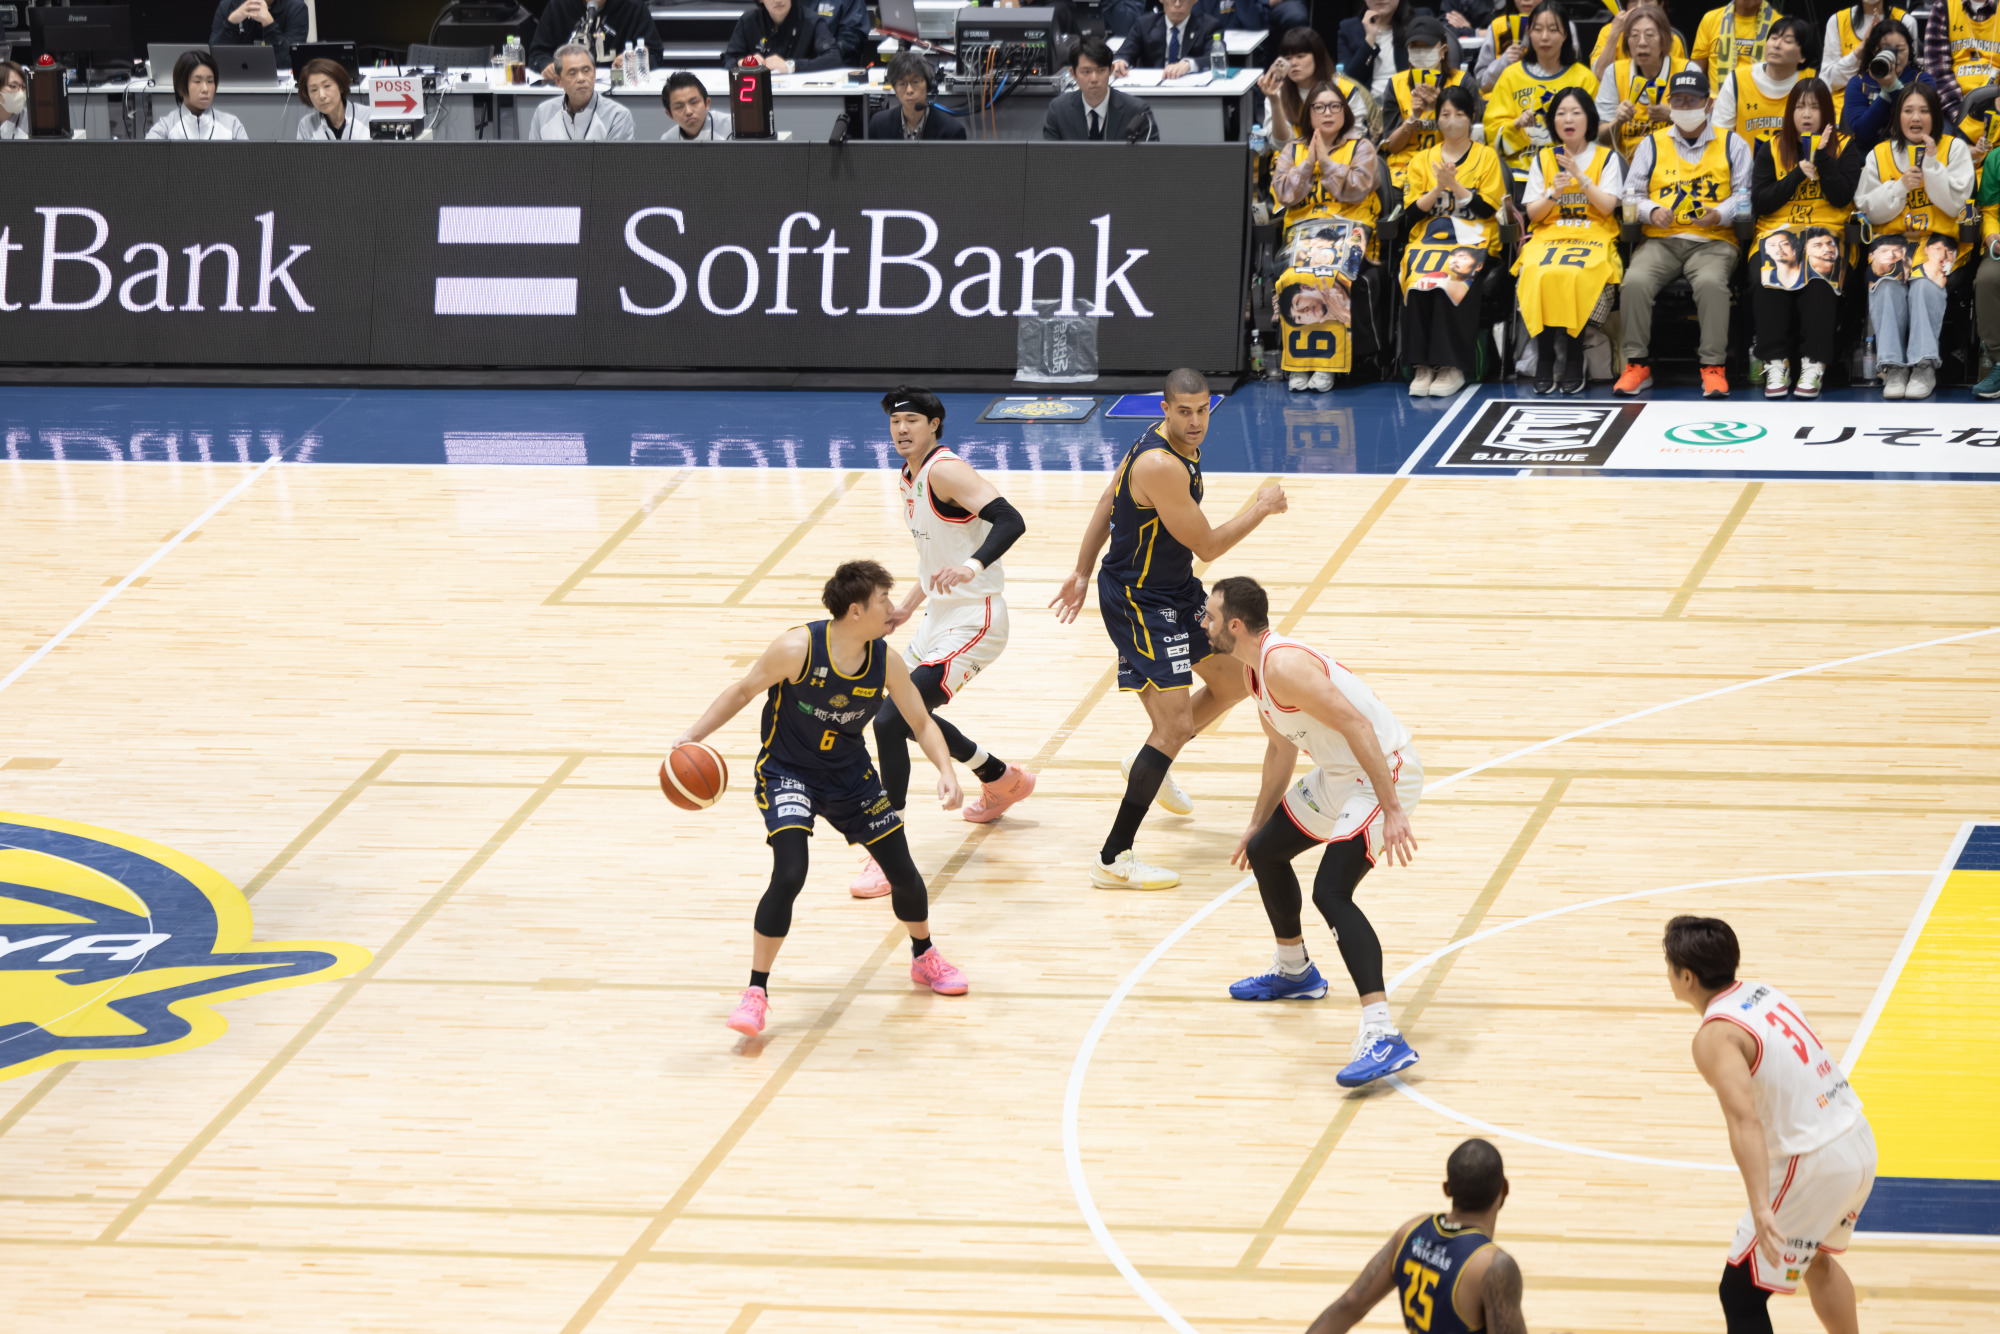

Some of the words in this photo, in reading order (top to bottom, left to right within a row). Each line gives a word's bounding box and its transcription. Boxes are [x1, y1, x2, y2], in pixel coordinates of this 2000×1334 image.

[375, 80, 415, 92] POSS.
[739, 76, 756, 102] 2
[1675, 77, 1697, 86] BREX
[1746, 117, 1784, 131] UTSUNO
[619, 207, 1154, 317] SoftBank
[1405, 249, 1451, 282] 10
[1539, 247, 1592, 269] 12
[1470, 452, 1589, 463] B.LEAGUE
[820, 729, 839, 751] 6
[1765, 1002, 1823, 1065] 31
[1403, 1259, 1440, 1332] 25
